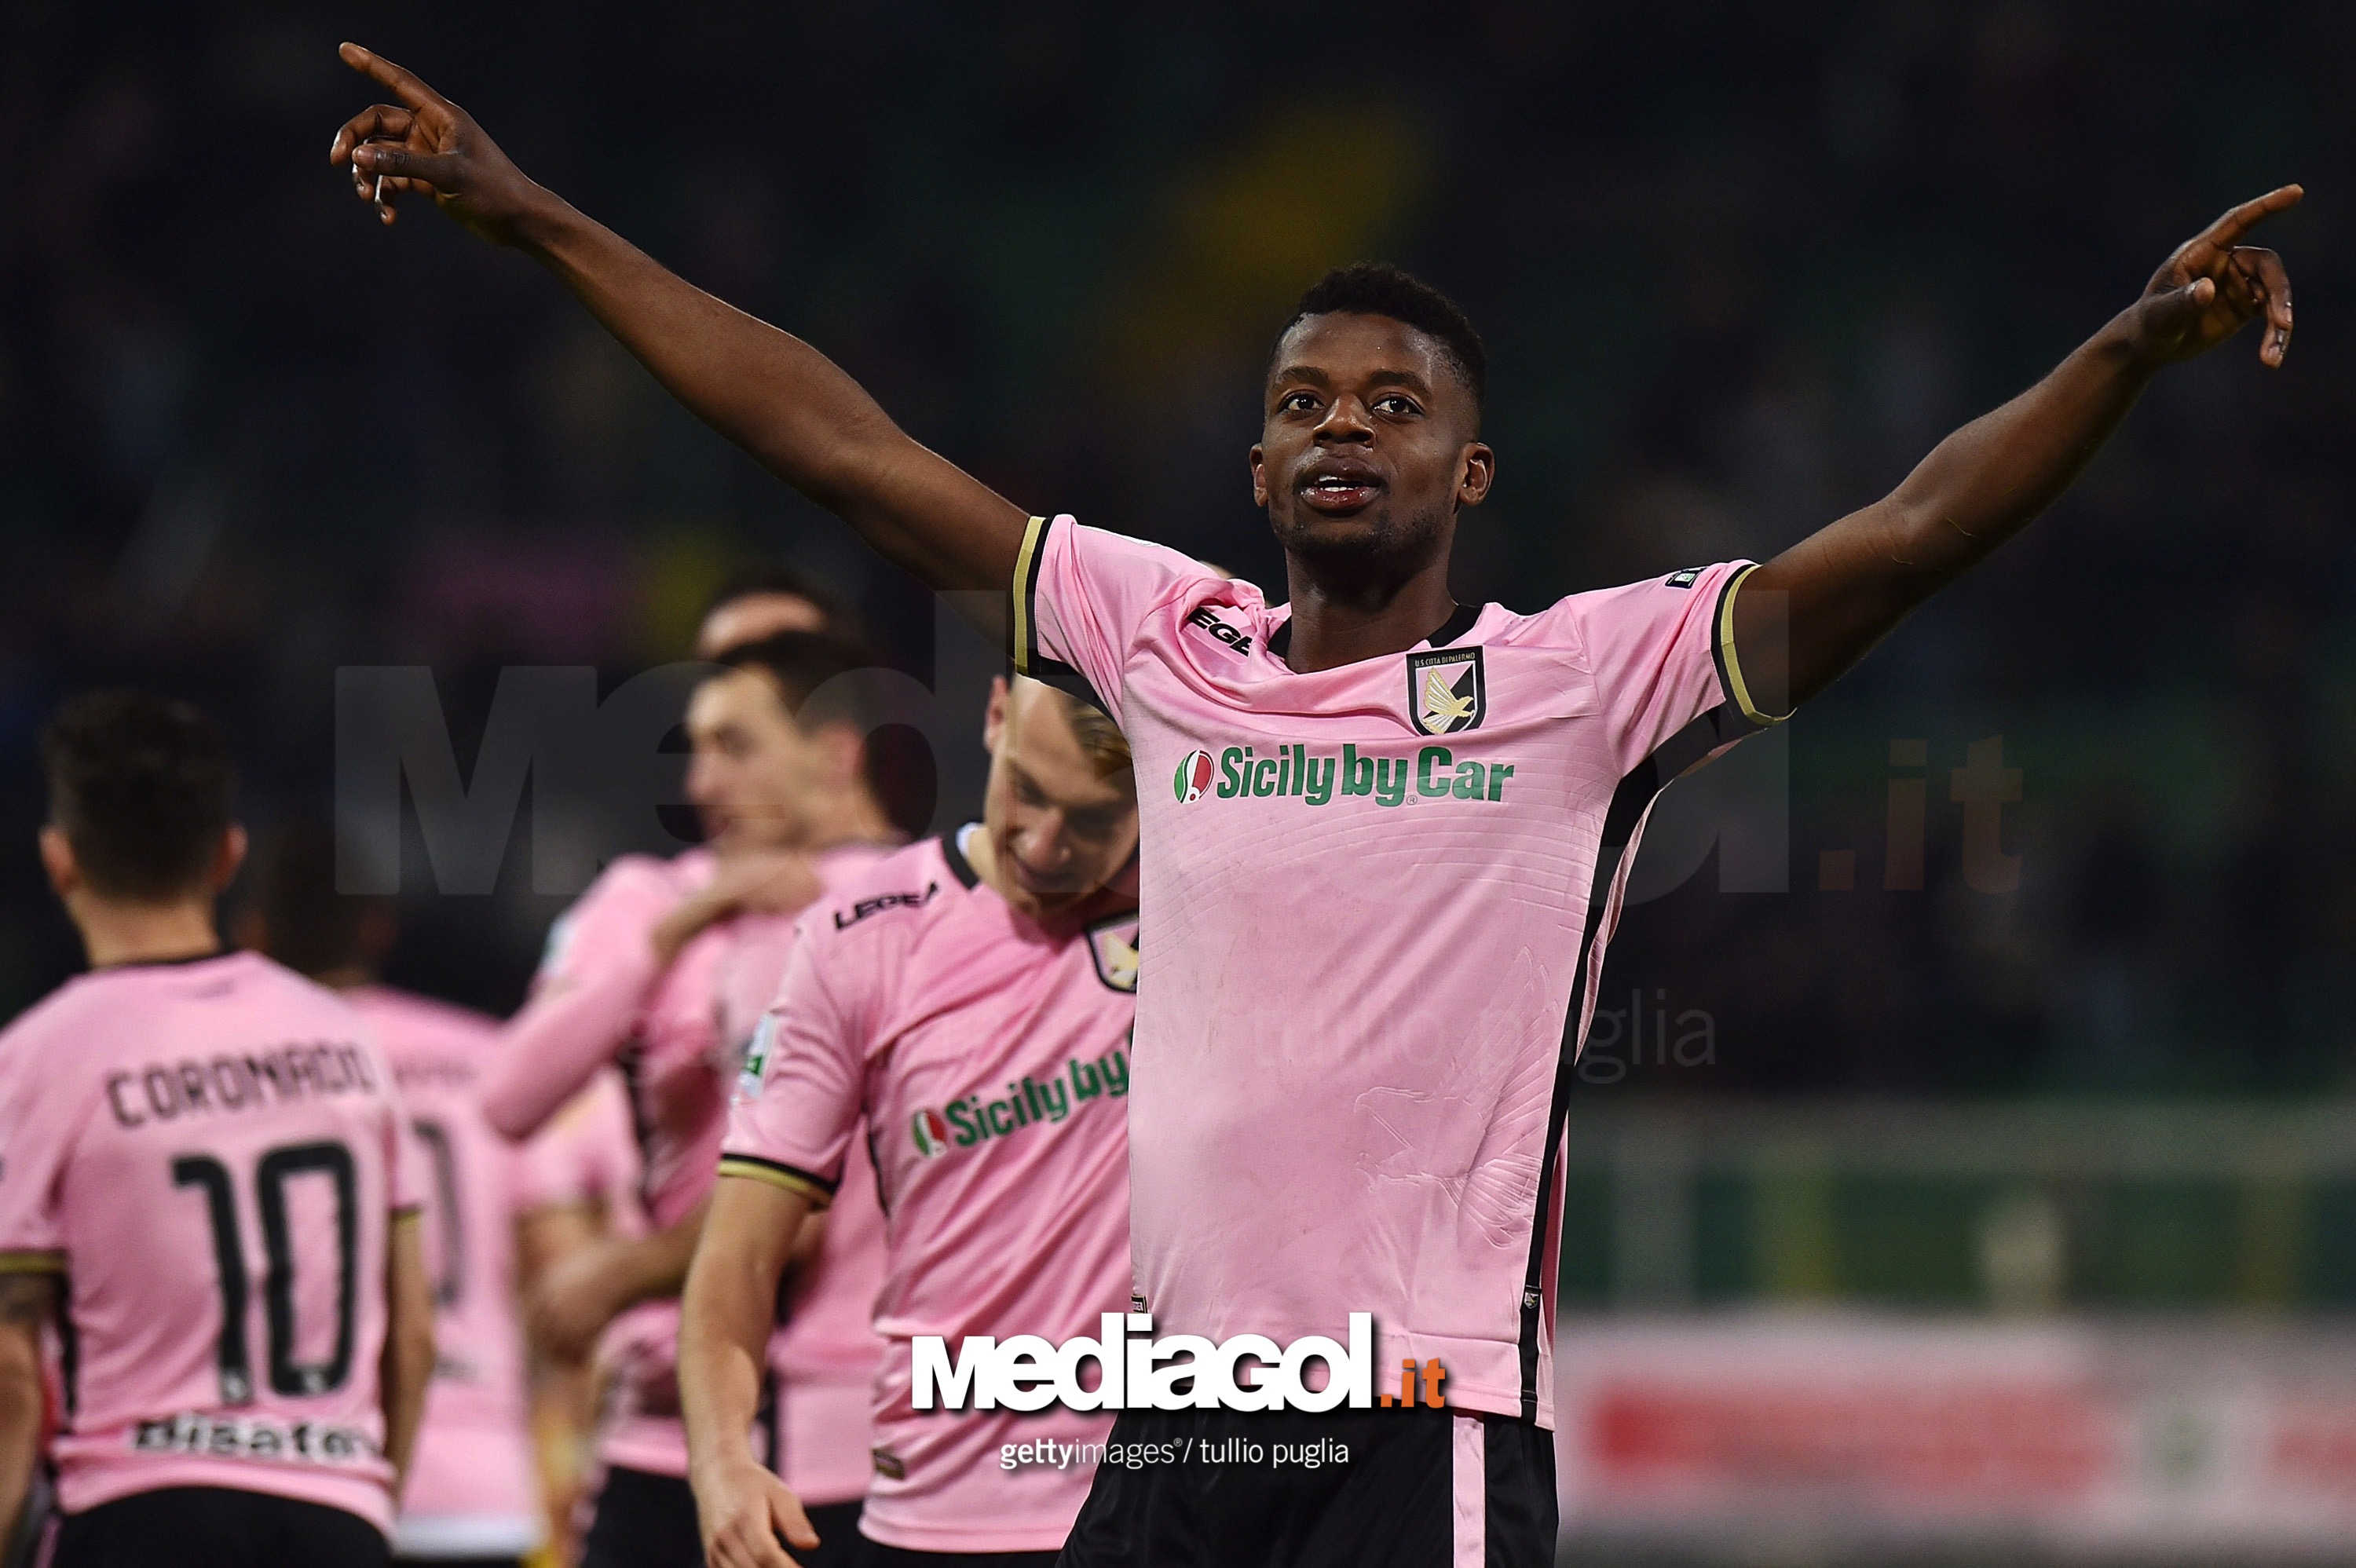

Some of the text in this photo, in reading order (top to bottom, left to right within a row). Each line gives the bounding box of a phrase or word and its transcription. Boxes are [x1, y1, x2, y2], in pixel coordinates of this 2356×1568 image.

[1449, 652, 1476, 663] PALERMO
[1216, 744, 1336, 806] Sicily
[1417, 746, 1516, 802] Car
[945, 1051, 1129, 1148] Sicily by
[174, 1141, 357, 1405] 10
